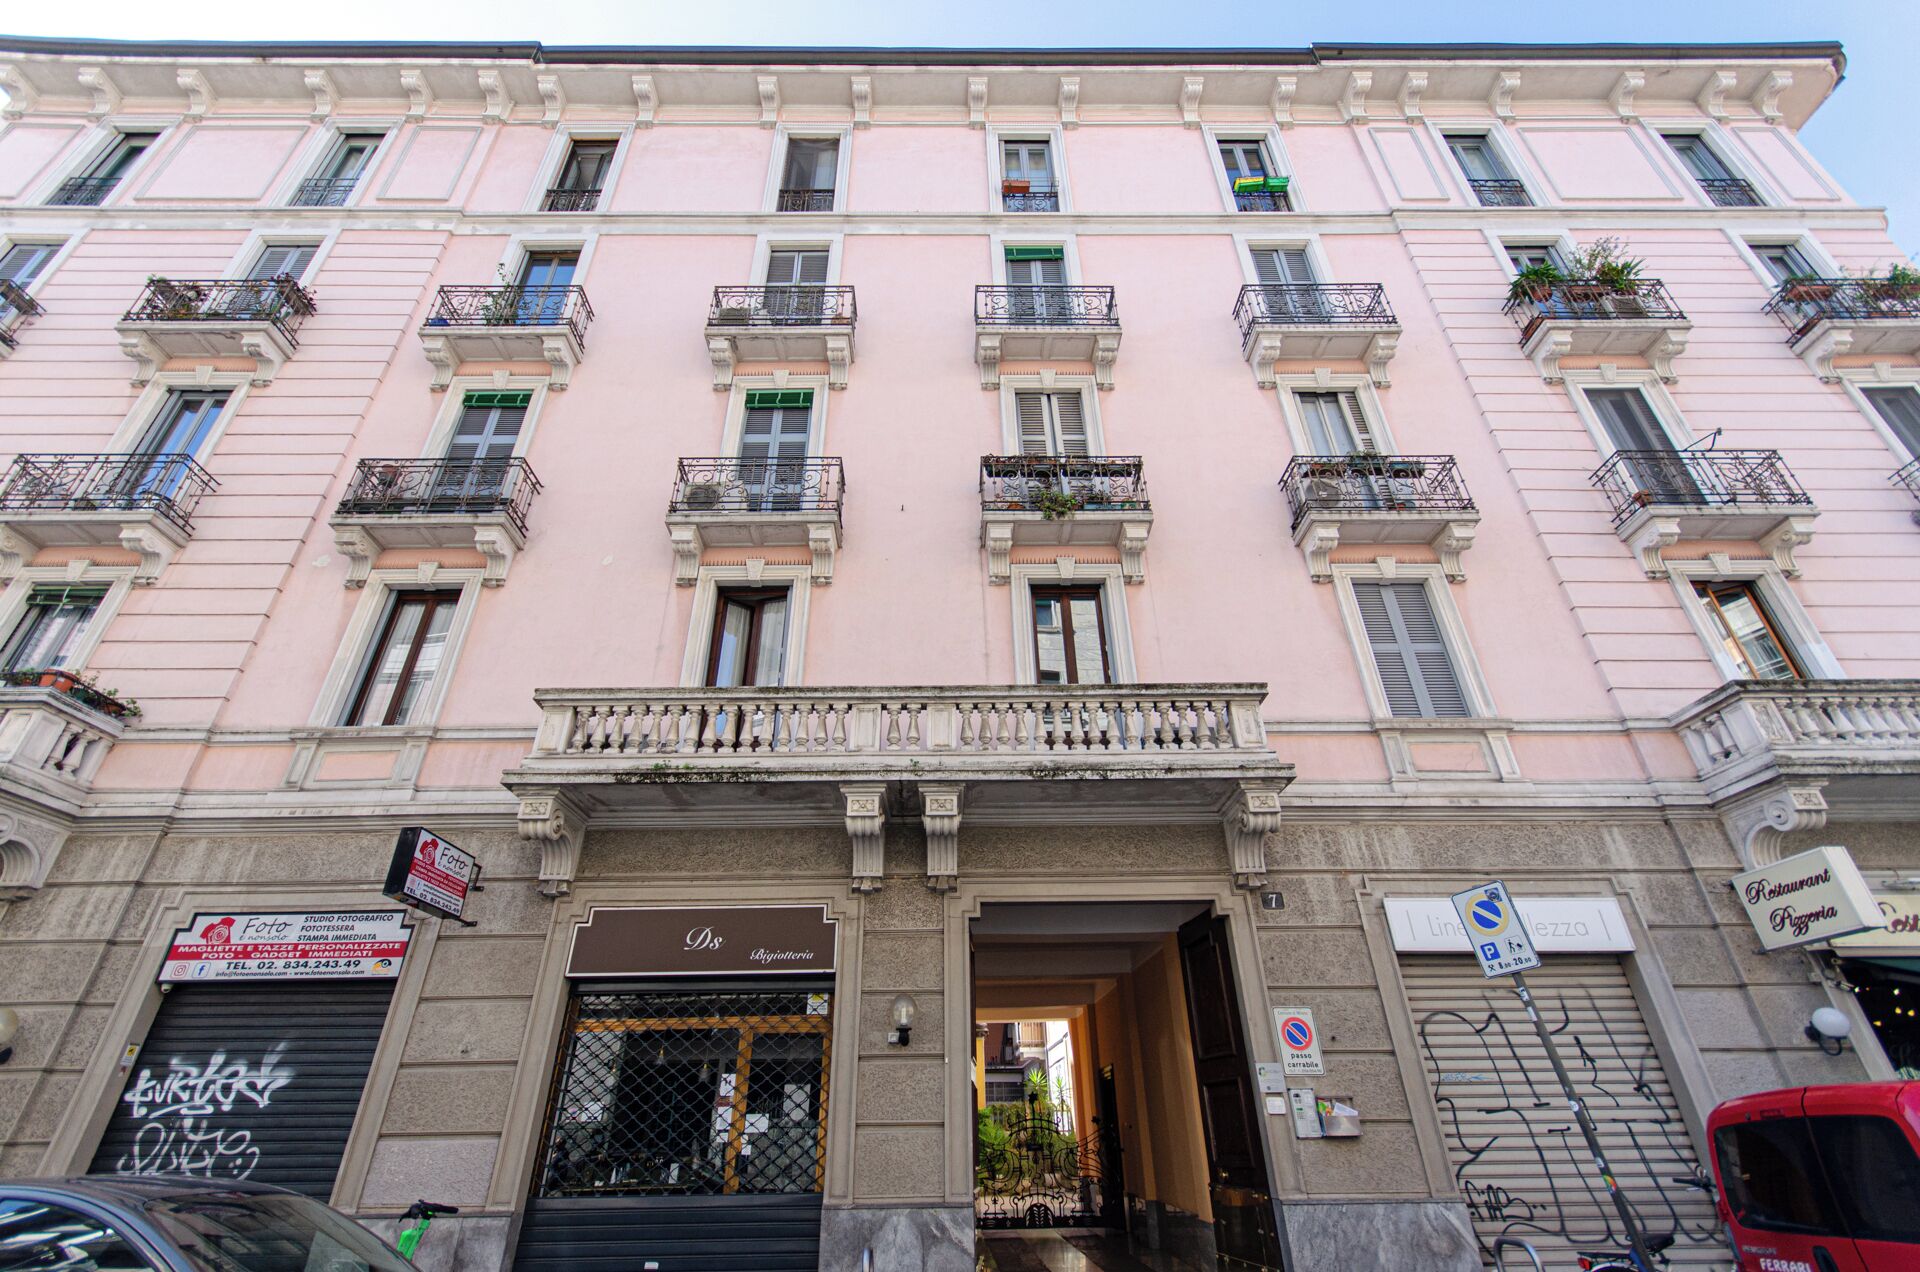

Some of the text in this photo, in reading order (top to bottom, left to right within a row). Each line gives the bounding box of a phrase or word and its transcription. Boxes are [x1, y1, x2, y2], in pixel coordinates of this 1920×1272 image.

[440, 847, 469, 869] Foto
[1745, 868, 1831, 905] Restaurant
[1268, 894, 1276, 908] 7
[243, 914, 394, 934] Foto STUDIO FOTOGRAFICO
[300, 924, 355, 932] FOTOTESSERA
[1427, 914, 1467, 937] Line
[1770, 905, 1837, 937] Pizzeria
[331, 933, 377, 941] IMMEDIATA
[683, 926, 726, 950] Ds
[178, 942, 401, 953] MAGLIETTE E TAZZE PERSONALIZZATE
[202, 950, 373, 960] FOTO GADGET IMMEDIATI
[1484, 945, 1495, 959] P
[750, 948, 814, 964] Bigiotteria
[226, 960, 361, 970] TEL. 02. 834.243.49
